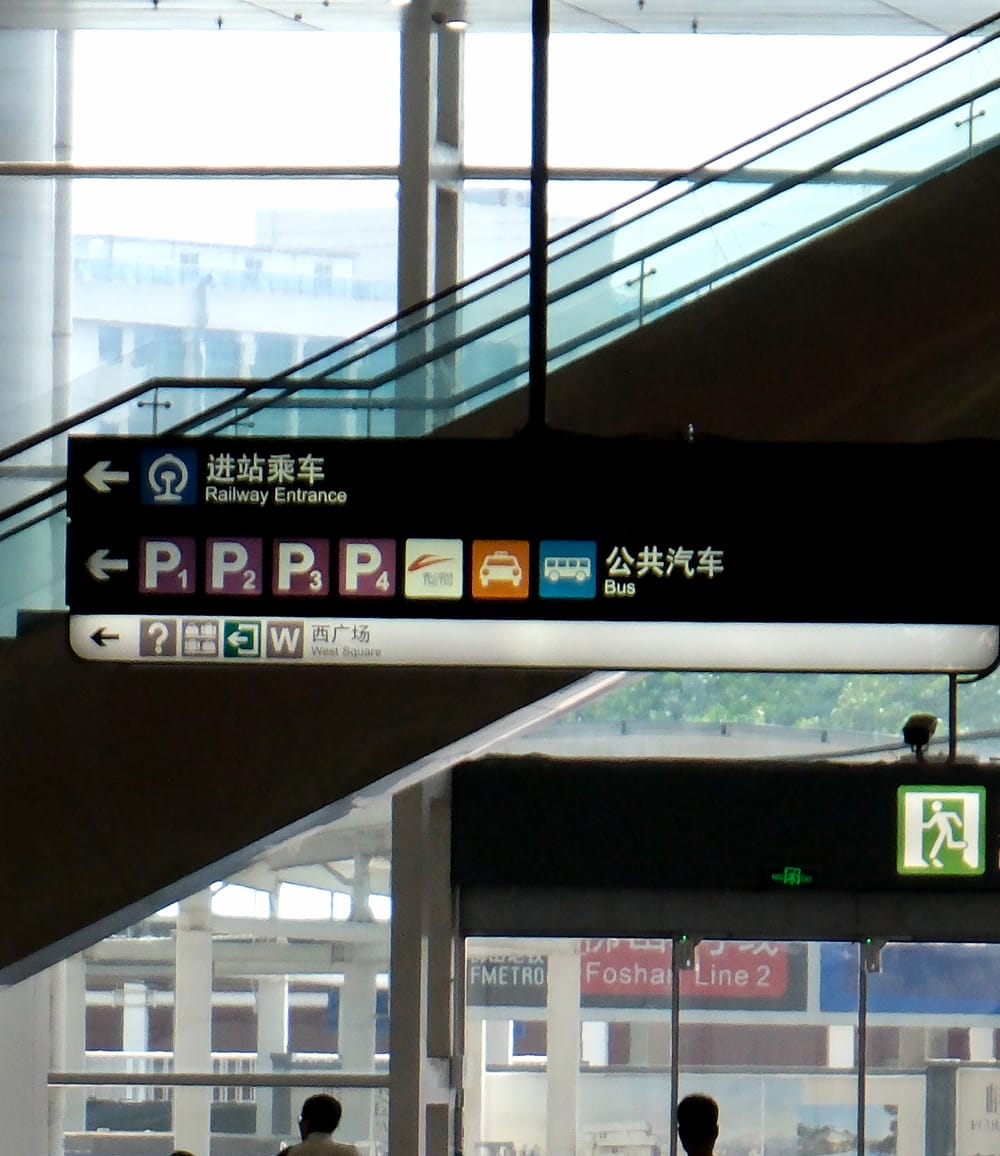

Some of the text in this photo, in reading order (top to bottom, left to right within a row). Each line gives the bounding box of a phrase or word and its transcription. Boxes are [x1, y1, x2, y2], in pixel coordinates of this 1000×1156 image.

[206, 453, 325, 485] 进站乘车
[205, 486, 348, 506] Railway Entrance
[605, 544, 725, 578] 公共汽车
[604, 578, 636, 596] Bus
[270, 627, 300, 652] W
[312, 624, 370, 643] 西广场
[311, 646, 382, 657] West Square
[470, 965, 545, 985] FMETRO
[694, 963, 749, 986] Line
[756, 964, 772, 986] 2
